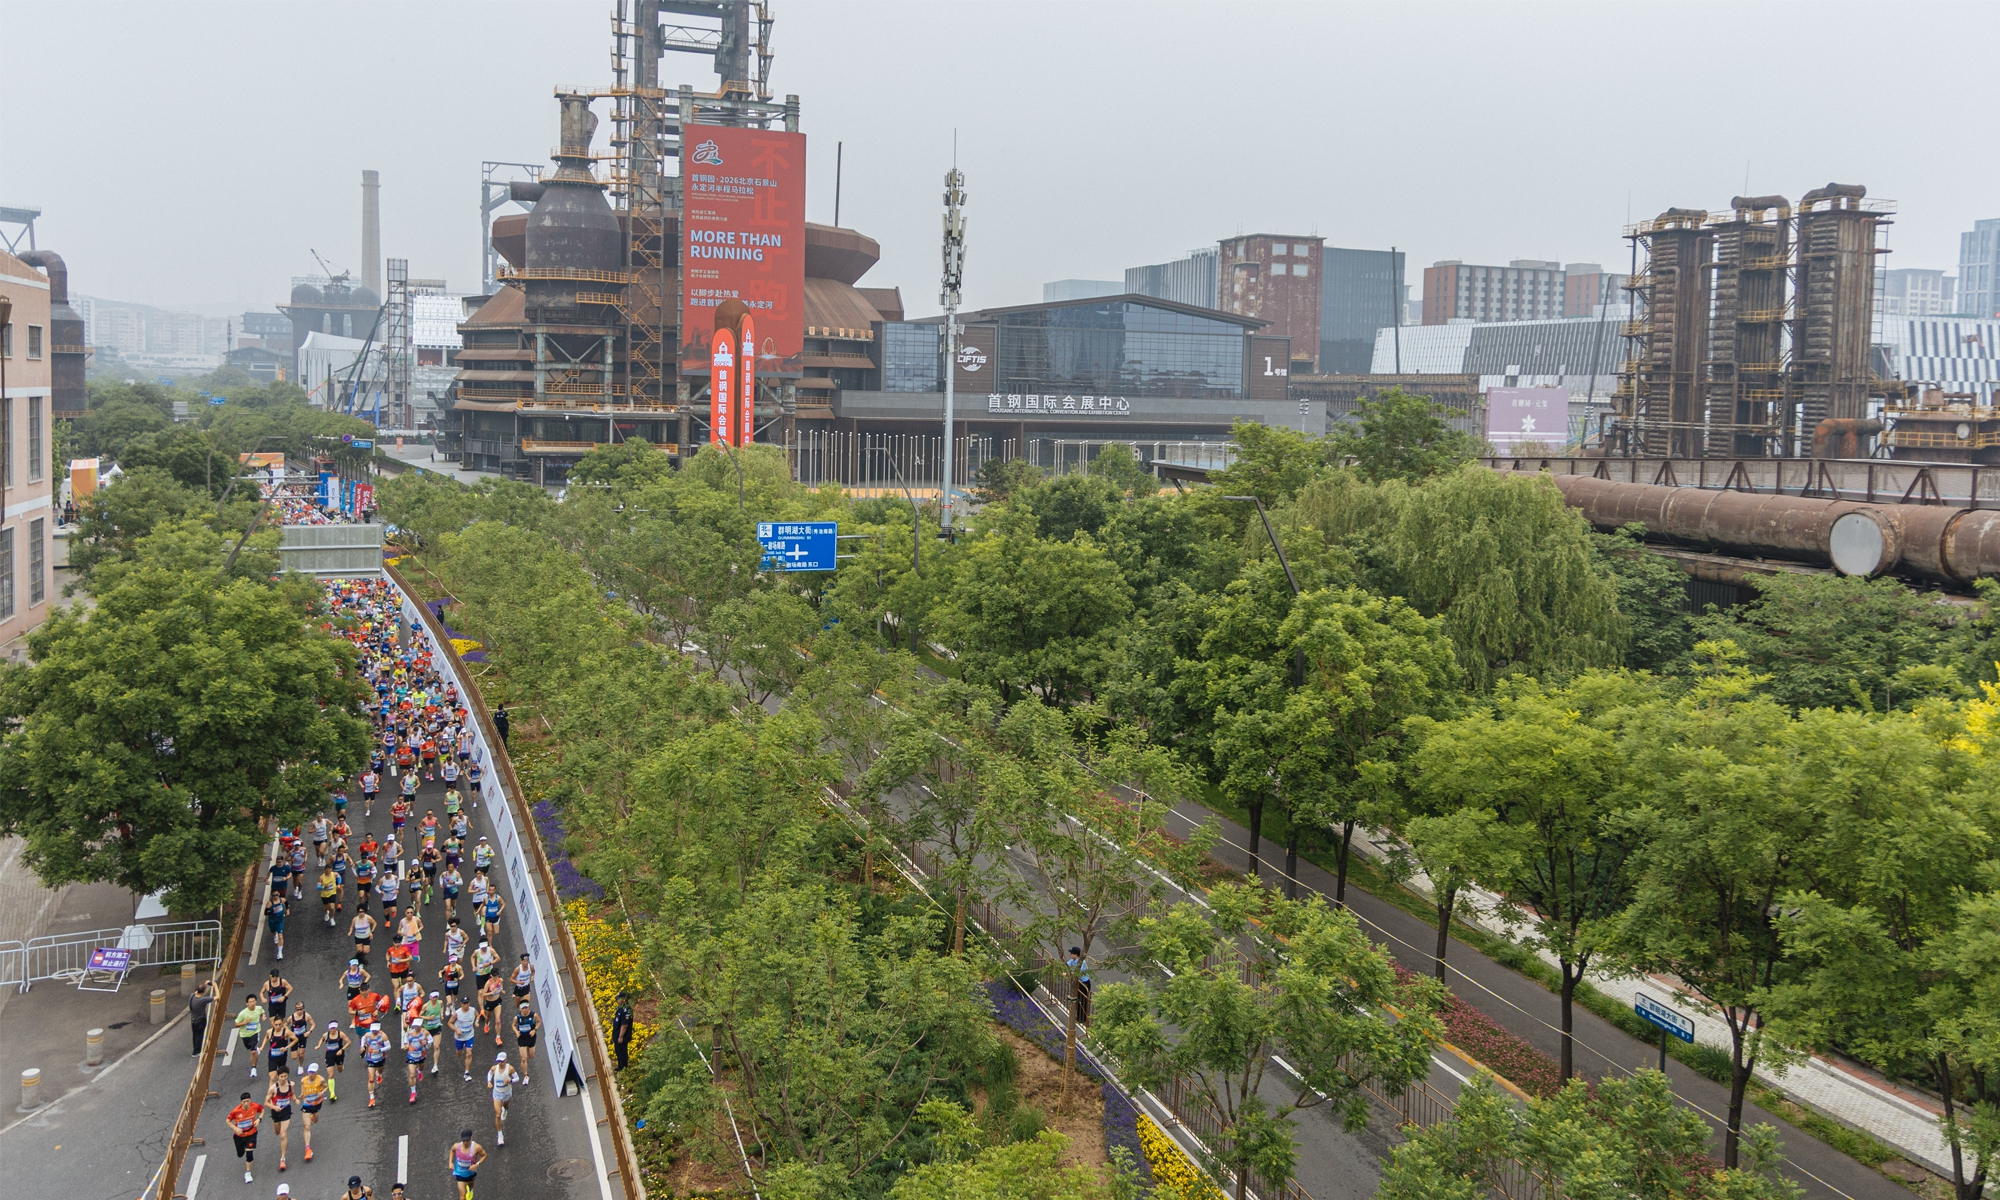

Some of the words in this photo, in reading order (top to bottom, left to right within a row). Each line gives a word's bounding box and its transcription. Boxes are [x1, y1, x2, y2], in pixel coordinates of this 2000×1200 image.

[691, 183, 755, 195] 永定河半程马拉松
[690, 229, 735, 245] MORE
[740, 232, 782, 247] THAN
[690, 245, 764, 261] RUNNING
[957, 355, 987, 364] CIFTIS
[988, 393, 1130, 411] 首钢国际会展中心
[101, 960, 125, 968] 禁止通行
